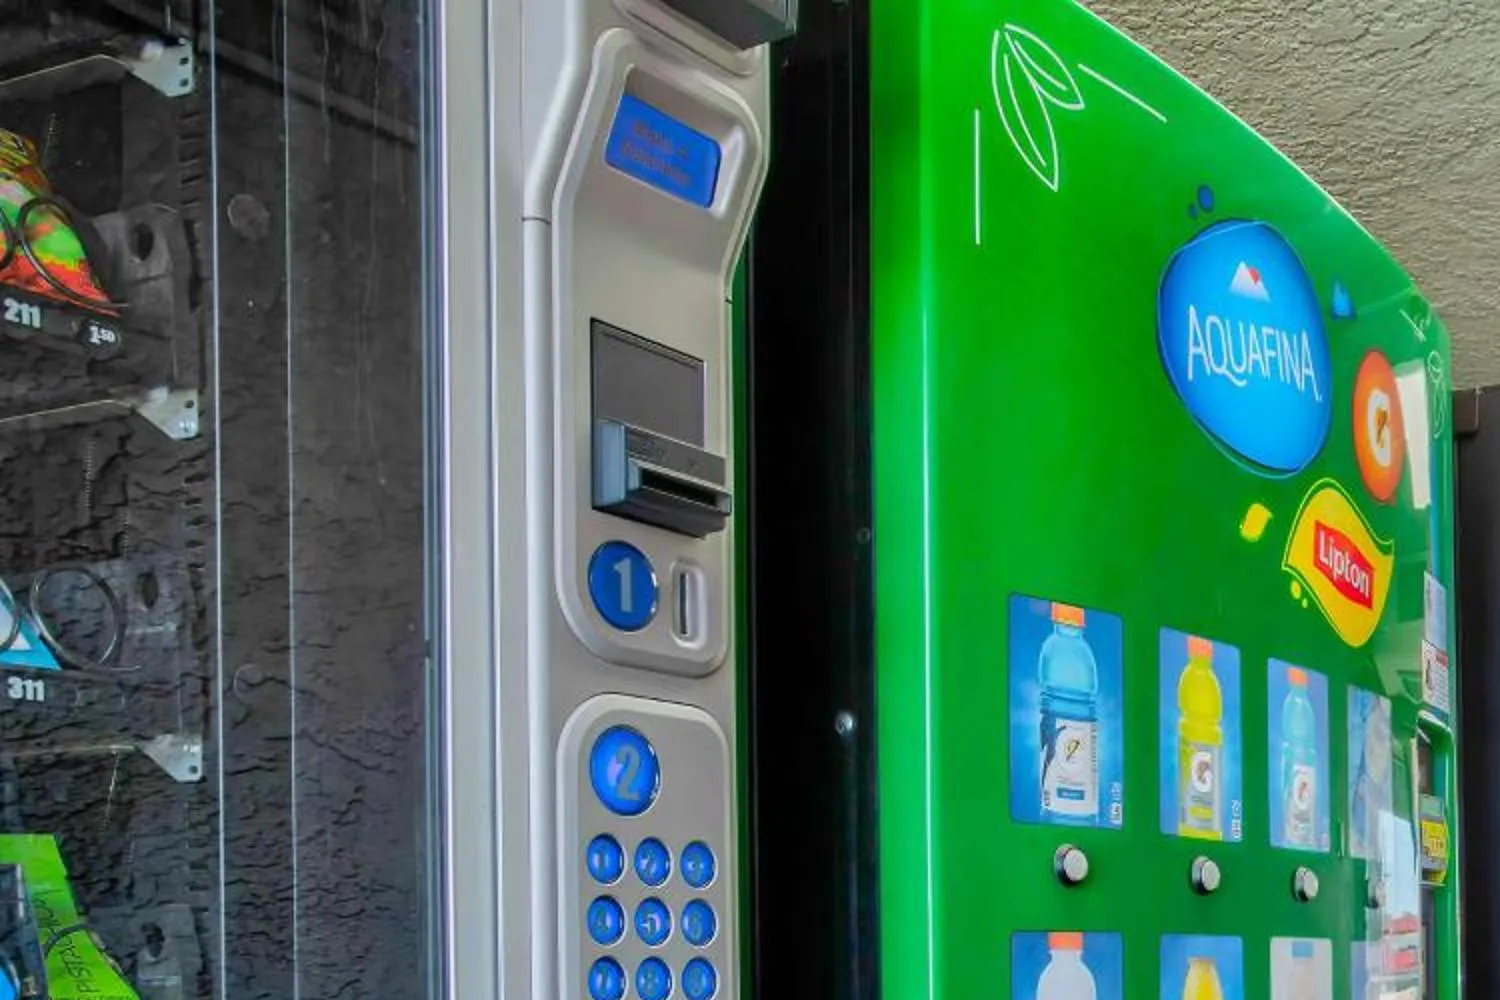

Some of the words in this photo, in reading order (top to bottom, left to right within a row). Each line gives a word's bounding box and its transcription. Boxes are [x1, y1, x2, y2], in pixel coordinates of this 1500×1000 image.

[3, 297, 41, 329] 211
[1187, 304, 1320, 401] AQUAFINA
[613, 557, 633, 613] 1
[1317, 526, 1370, 599] Lipton
[7, 676, 45, 701] 311
[615, 744, 641, 801] 2
